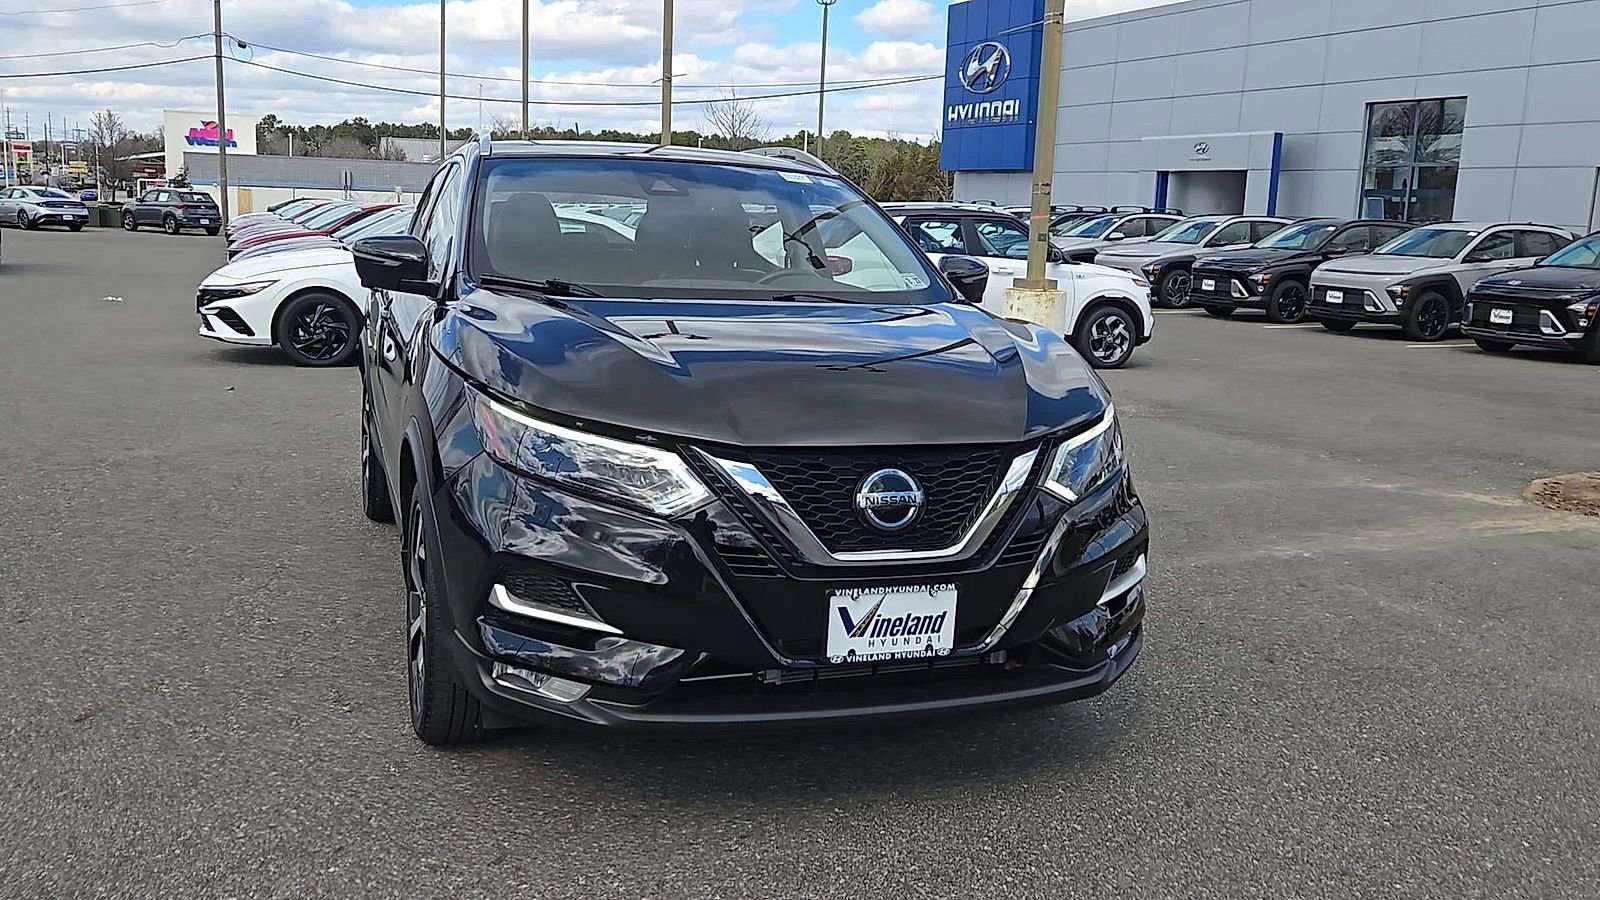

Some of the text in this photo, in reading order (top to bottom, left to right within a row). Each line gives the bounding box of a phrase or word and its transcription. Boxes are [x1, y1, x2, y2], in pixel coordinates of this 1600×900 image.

[948, 99, 1020, 122] HYUNDAI
[865, 495, 917, 506] NISSAN
[835, 583, 956, 597] VINELANDHYUNDAI.COM
[837, 593, 948, 639] Vineland
[868, 635, 942, 648] HYUNDAI
[846, 649, 936, 663] VINELAND HYUNDAI
